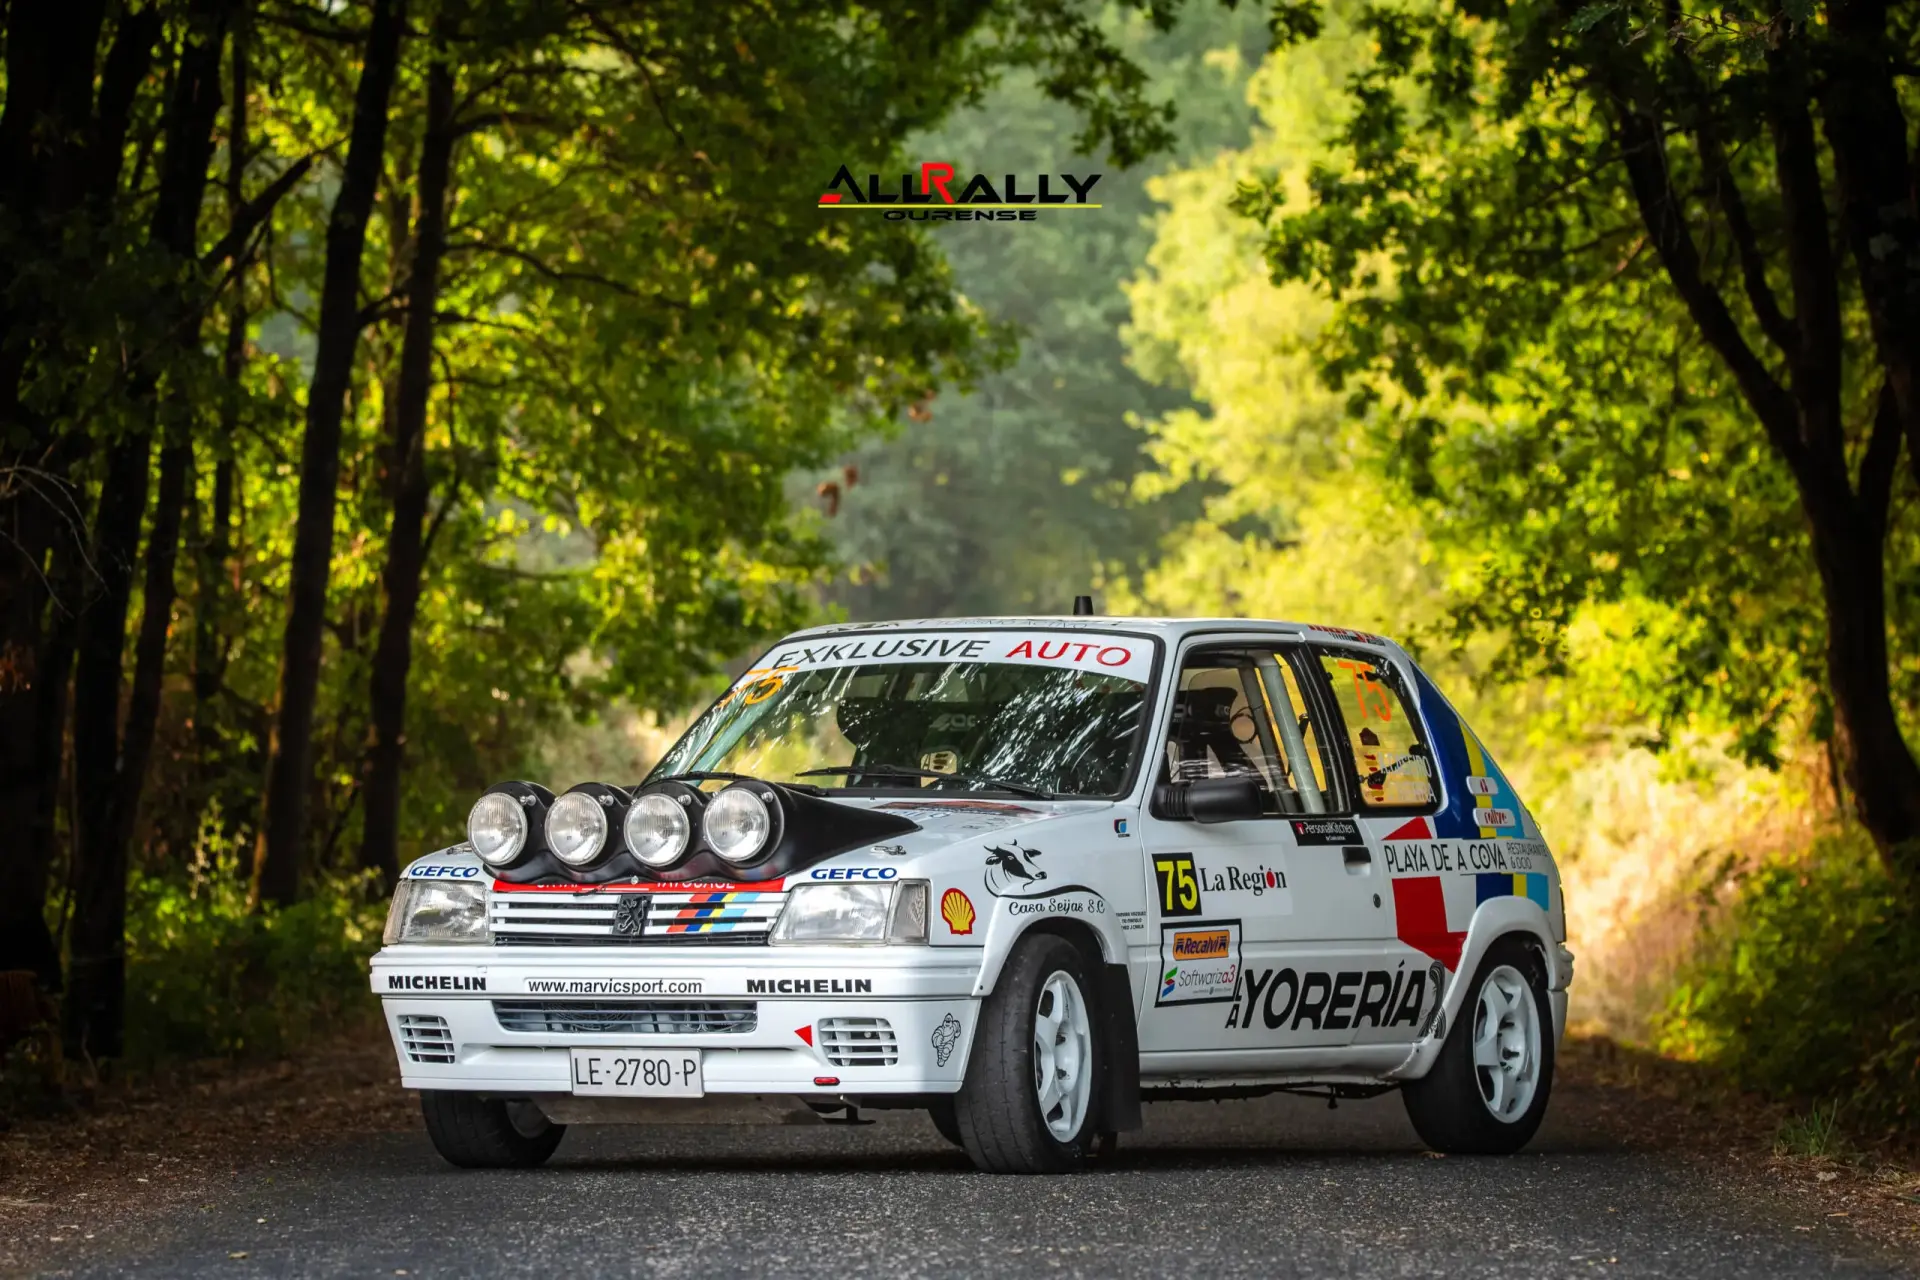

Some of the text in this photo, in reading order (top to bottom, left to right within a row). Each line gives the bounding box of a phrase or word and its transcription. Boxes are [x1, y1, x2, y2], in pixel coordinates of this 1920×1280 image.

[772, 639, 1132, 669] EXKLUSIVE AUTO
[1337, 660, 1392, 721] 75
[1384, 842, 1507, 872] PLAYA DE A COVA
[411, 866, 479, 878] GEFCO
[811, 867, 898, 879] GEFCO
[1156, 860, 1287, 911] 75 La Región
[1008, 900, 1045, 916] Casa
[1048, 897, 1084, 915] Seijas
[1183, 936, 1219, 955] Recalvi
[388, 975, 487, 991] MICHELIN
[528, 978, 703, 995] www.marvicsport.com
[746, 978, 872, 993] MICHELIN
[1178, 963, 1236, 988] Softwariza3
[1242, 959, 1427, 1031] YORERÍA
[574, 1057, 697, 1087] LE-2780-P
